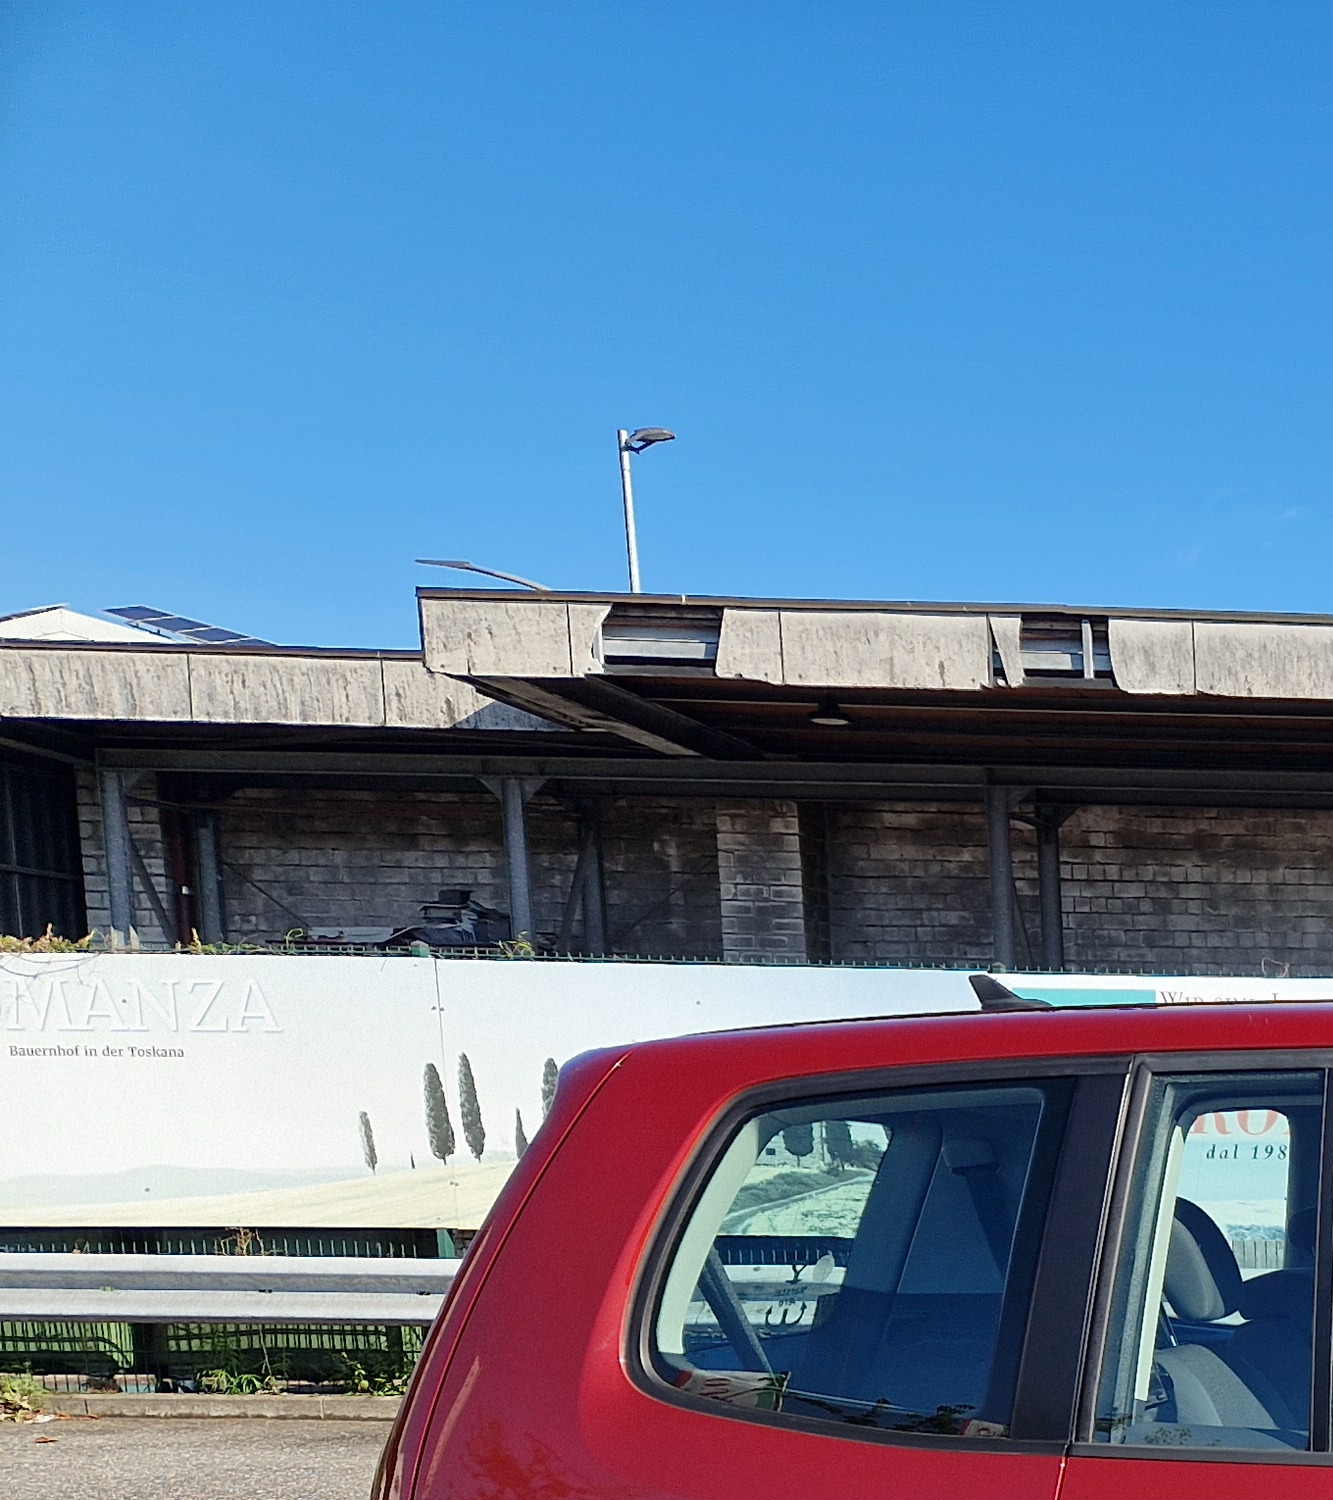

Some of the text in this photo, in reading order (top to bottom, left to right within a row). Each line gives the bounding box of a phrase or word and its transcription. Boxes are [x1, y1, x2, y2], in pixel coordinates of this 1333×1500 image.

[9, 1044, 185, 1058] Bauernhof in der Toskana
[1206, 1143, 1289, 1161] dal 198
